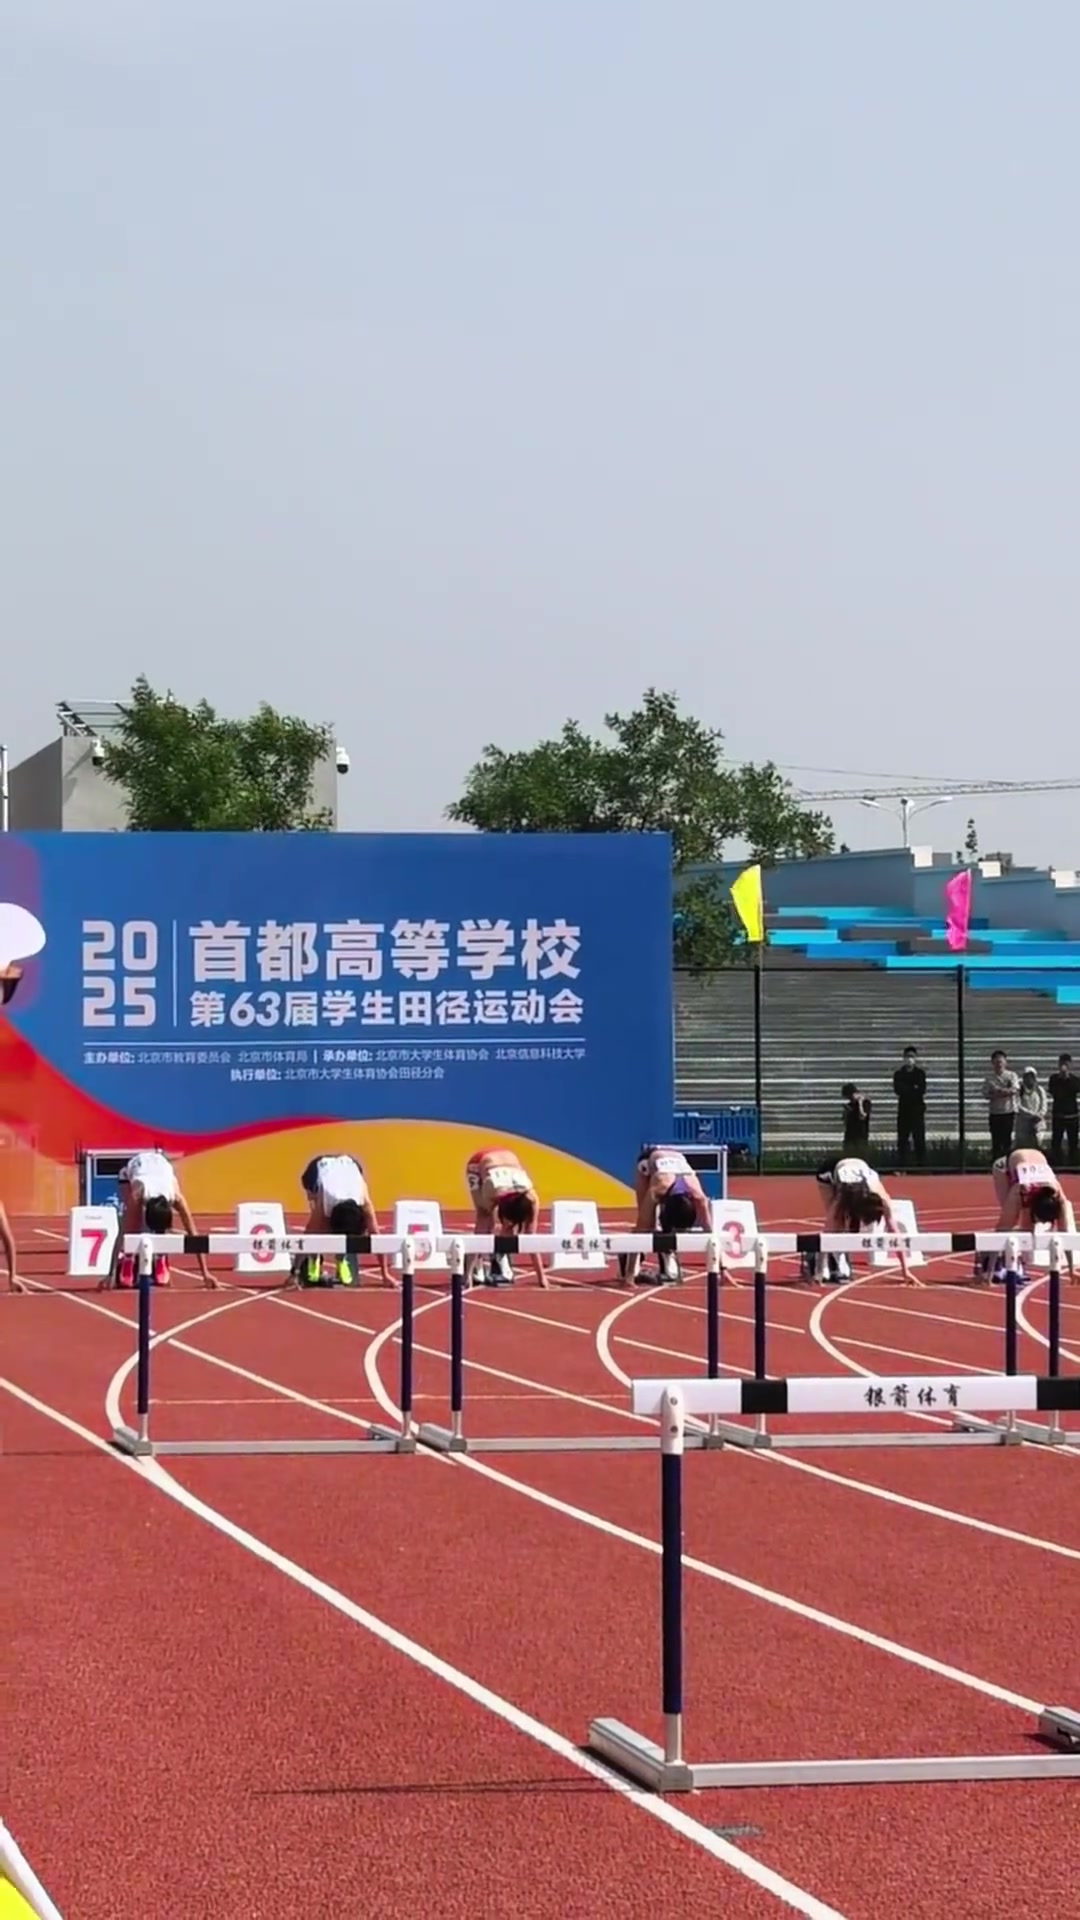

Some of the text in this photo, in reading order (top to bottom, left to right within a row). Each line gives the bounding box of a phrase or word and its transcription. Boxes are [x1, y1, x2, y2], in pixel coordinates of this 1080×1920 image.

[82, 920, 158, 971] 20
[189, 919, 581, 983] 首都高等学校
[83, 976, 157, 1027] 25
[190, 988, 584, 1028] 第63届学生田径运动会
[81, 1228, 108, 1267] 7
[721, 1221, 747, 1259] 3
[864, 1383, 960, 1408] 银箭体育
